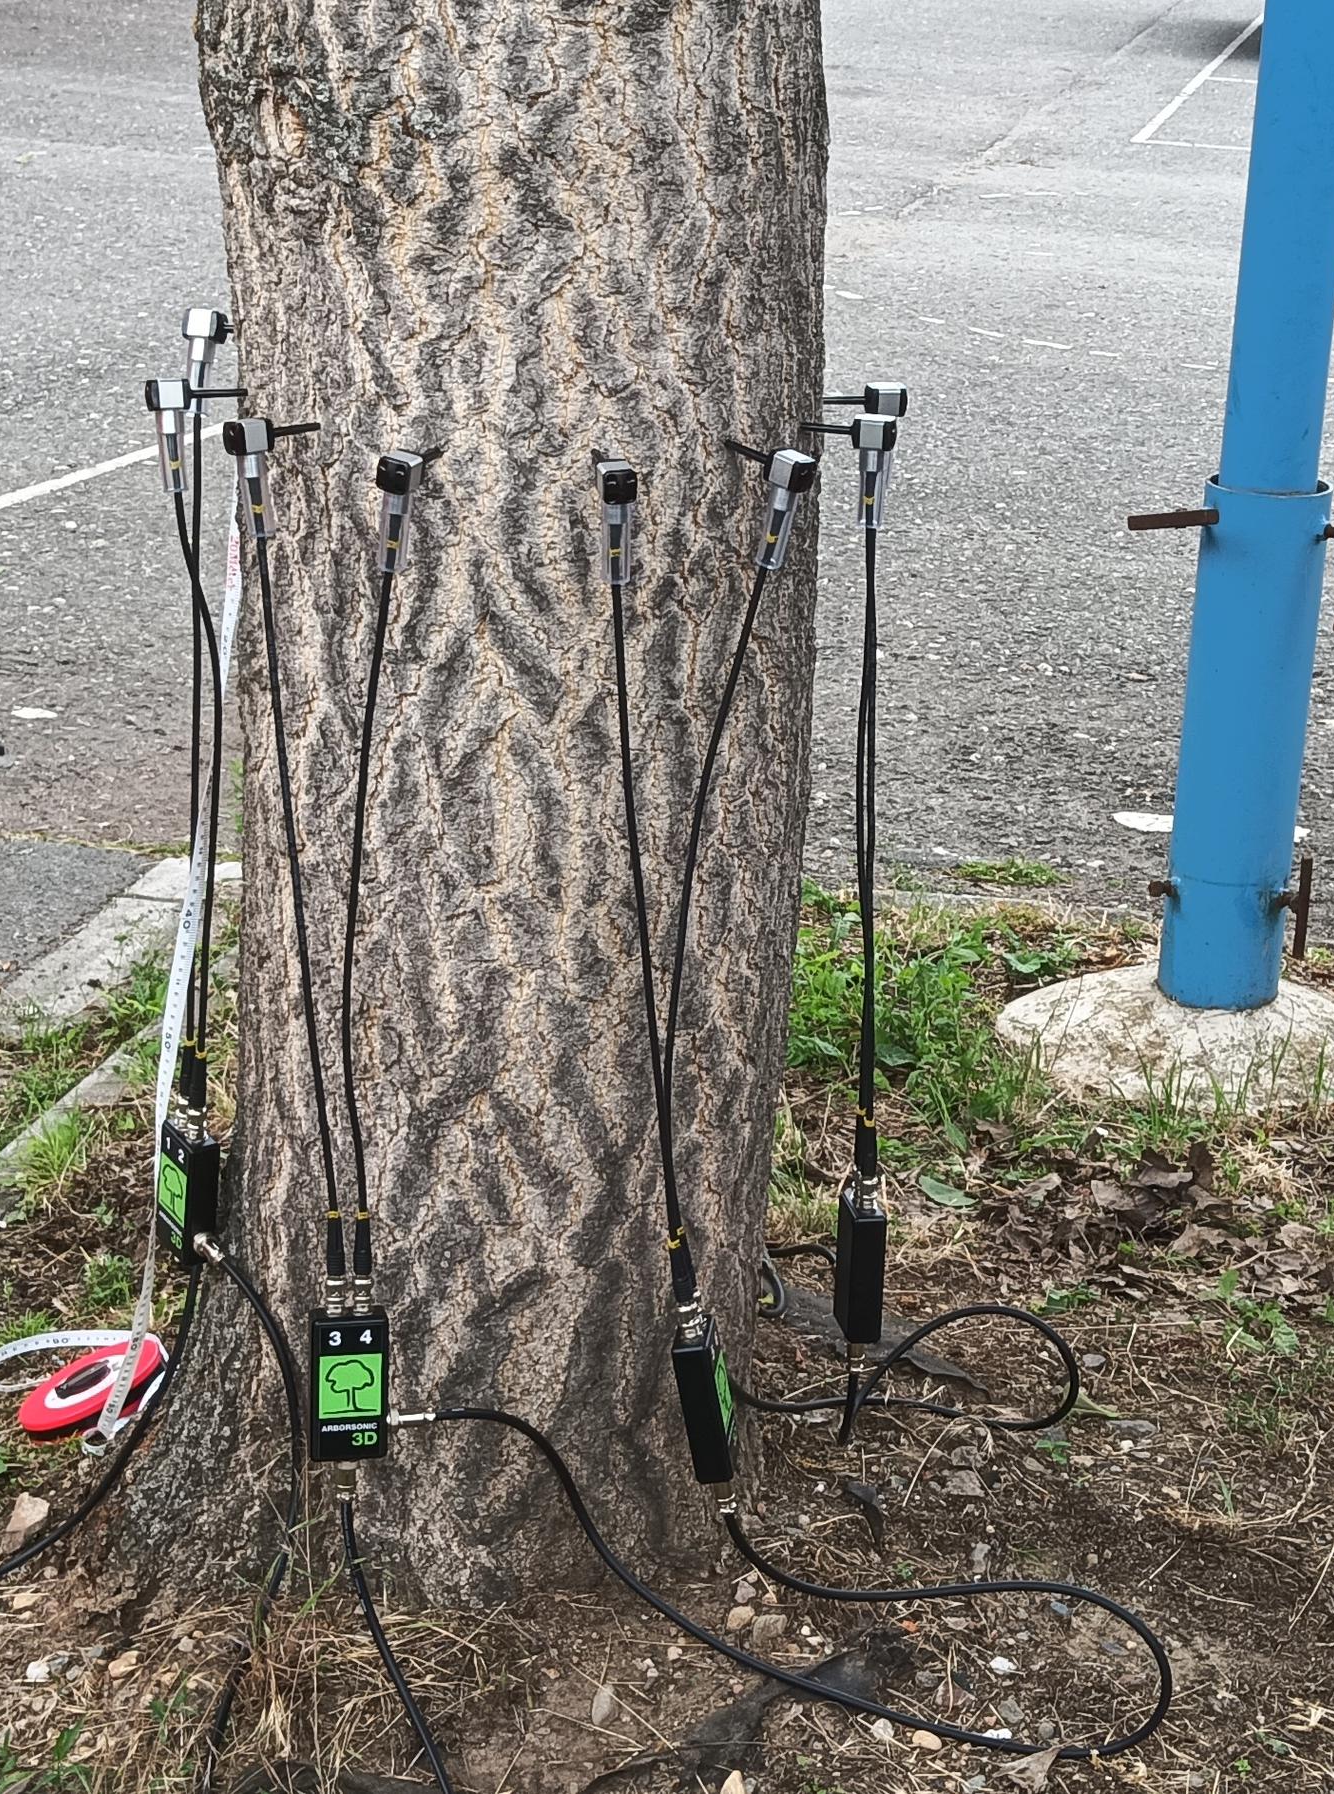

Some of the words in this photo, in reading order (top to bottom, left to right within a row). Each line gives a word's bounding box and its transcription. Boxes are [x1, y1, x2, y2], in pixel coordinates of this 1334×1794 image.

[183, 909, 192, 929] 40
[167, 1137, 171, 1149] 1
[178, 1149, 185, 1164] 2
[170, 1230, 183, 1250] 3D
[328, 1331, 342, 1346] 3
[359, 1329, 373, 1344] 4
[321, 1422, 378, 1433] ARBORSONIC
[351, 1431, 378, 1446] 3D
